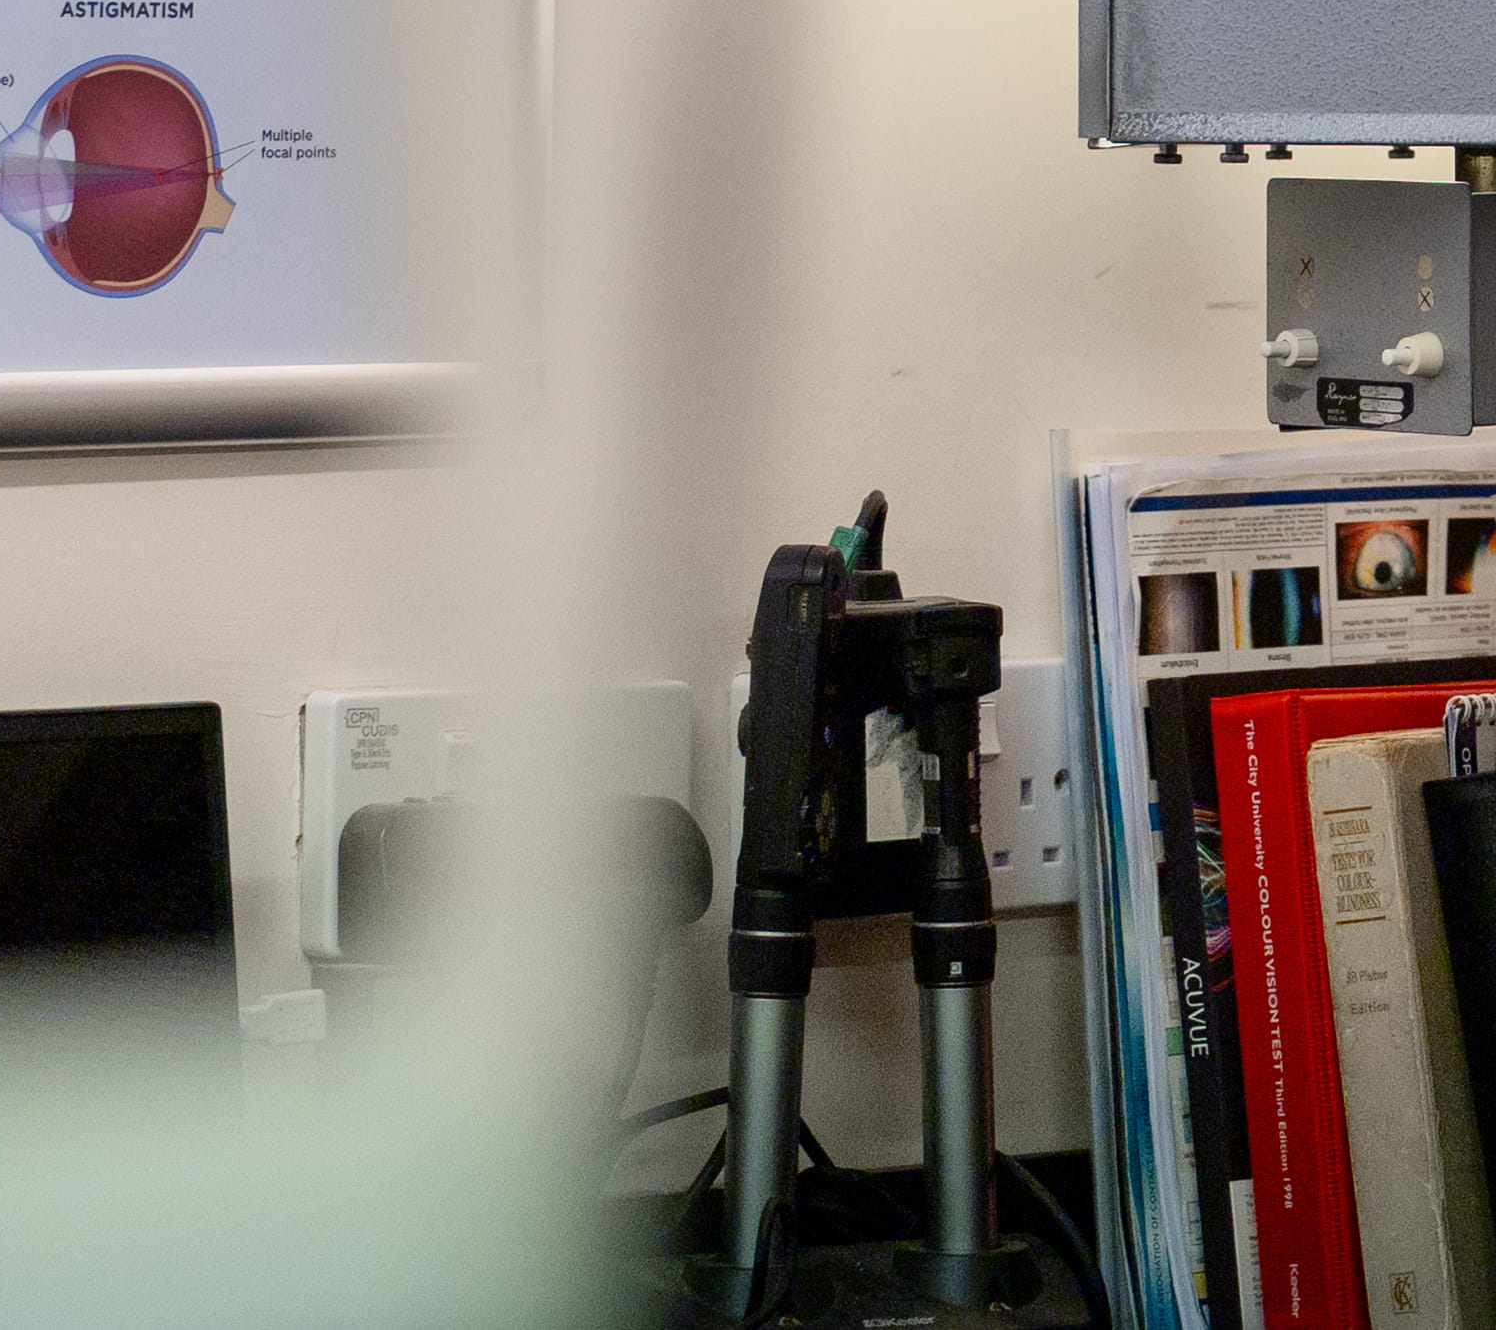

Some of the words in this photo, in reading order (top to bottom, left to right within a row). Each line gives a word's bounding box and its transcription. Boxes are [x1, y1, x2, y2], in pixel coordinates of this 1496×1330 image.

[61, 1, 195, 19] ASTIGMATISM
[261, 146, 293, 159] focal
[297, 147, 337, 162] points
[262, 129, 313, 143] Multiple
[1243, 719, 1259, 751] The
[1246, 754, 1261, 787] City
[1248, 791, 1267, 871] University
[1257, 874, 1276, 957] COLOUR
[1181, 957, 1209, 1058] ACUVUE
[1262, 958, 1280, 1024] VISION
[1270, 1025, 1285, 1073] TEST
[1274, 1077, 1288, 1117] Third
[1276, 1121, 1291, 1172] Edition
[1282, 1176, 1294, 1209] 1998
[1287, 1262, 1301, 1319] Keeler
